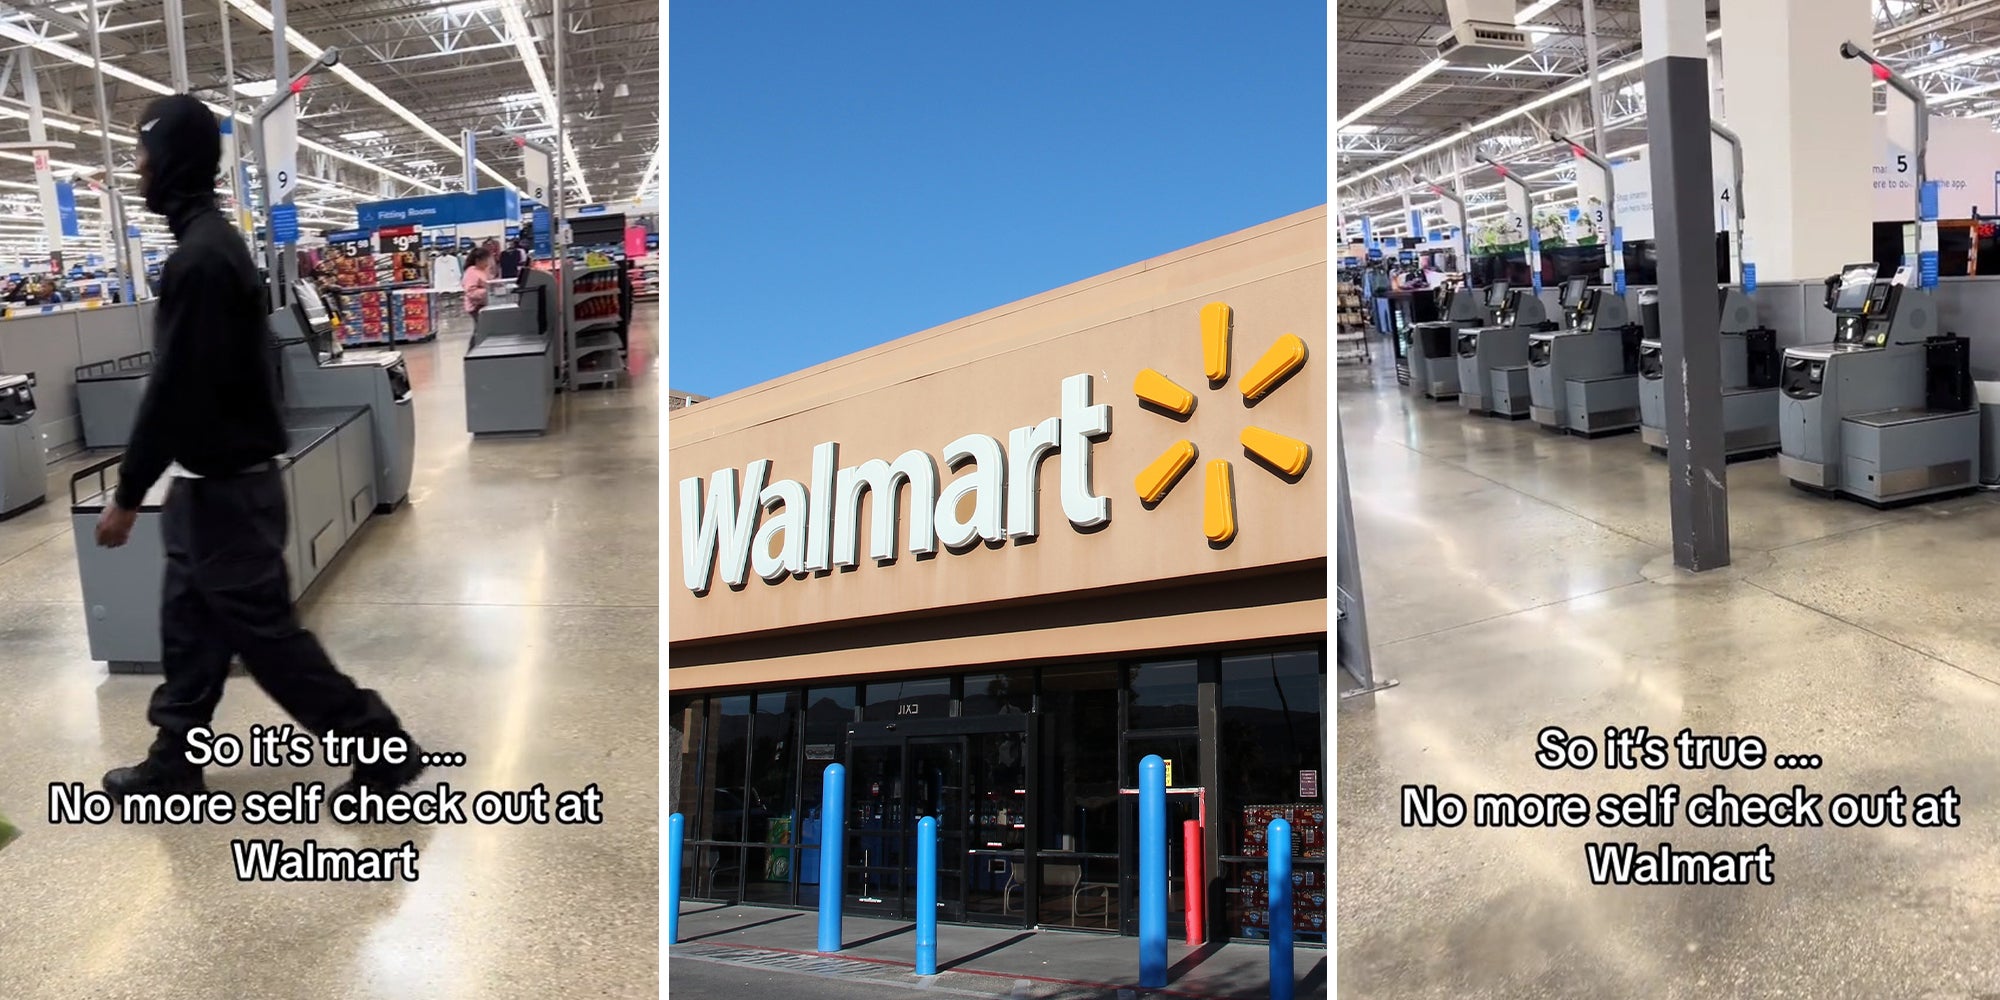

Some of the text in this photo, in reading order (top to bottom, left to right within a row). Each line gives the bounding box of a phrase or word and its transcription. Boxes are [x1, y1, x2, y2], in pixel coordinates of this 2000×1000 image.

[1896, 154, 1908, 173] 5
[277, 170, 288, 189] 9
[1720, 188, 1730, 202] 4
[378, 207, 437, 220] Fitting Rooms
[1596, 209, 1604, 222] 3
[1515, 216, 1522, 228] 2
[679, 372, 1112, 592] Walmart
